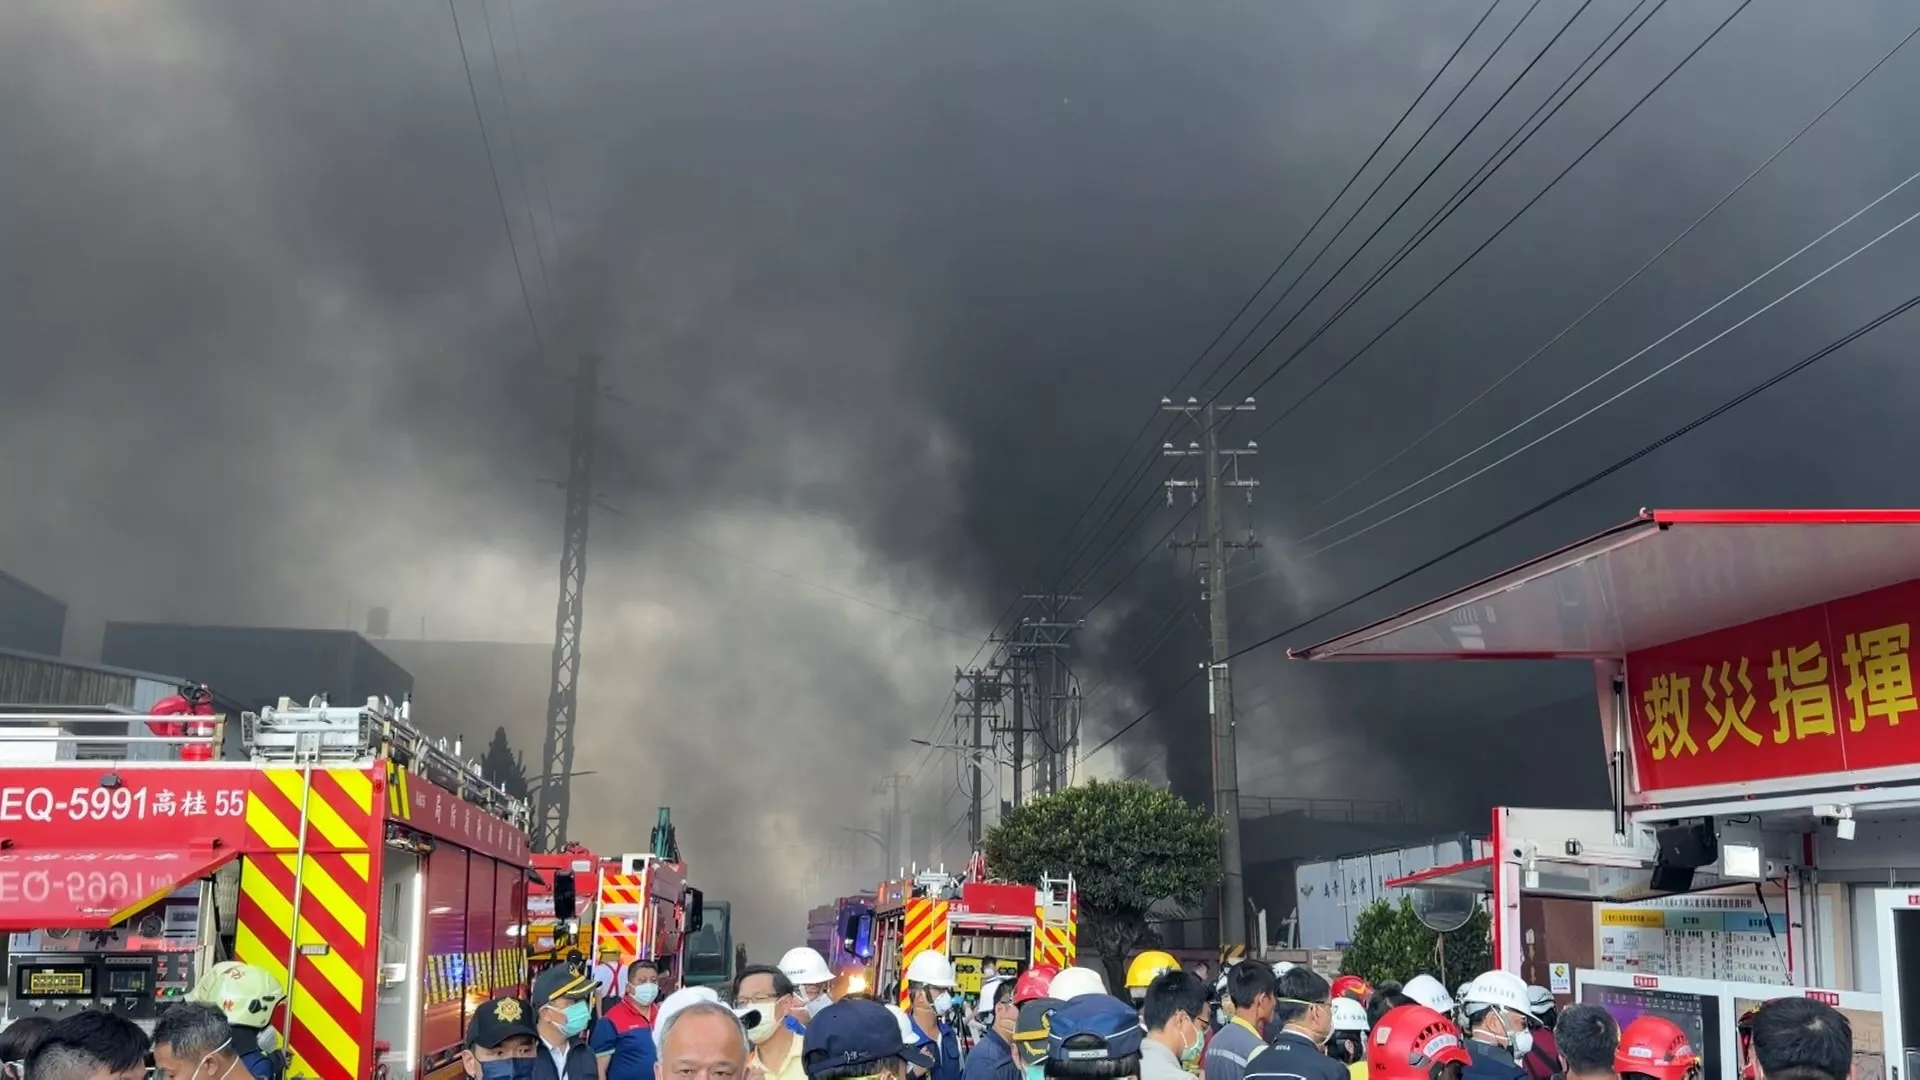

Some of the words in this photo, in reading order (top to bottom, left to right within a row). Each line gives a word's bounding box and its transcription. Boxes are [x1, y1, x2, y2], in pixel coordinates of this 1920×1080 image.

[1643, 623, 1918, 760] 救災指揮
[0, 787, 147, 822] EQ-5991
[151, 788, 208, 817] 高桂
[214, 789, 244, 817] 55
